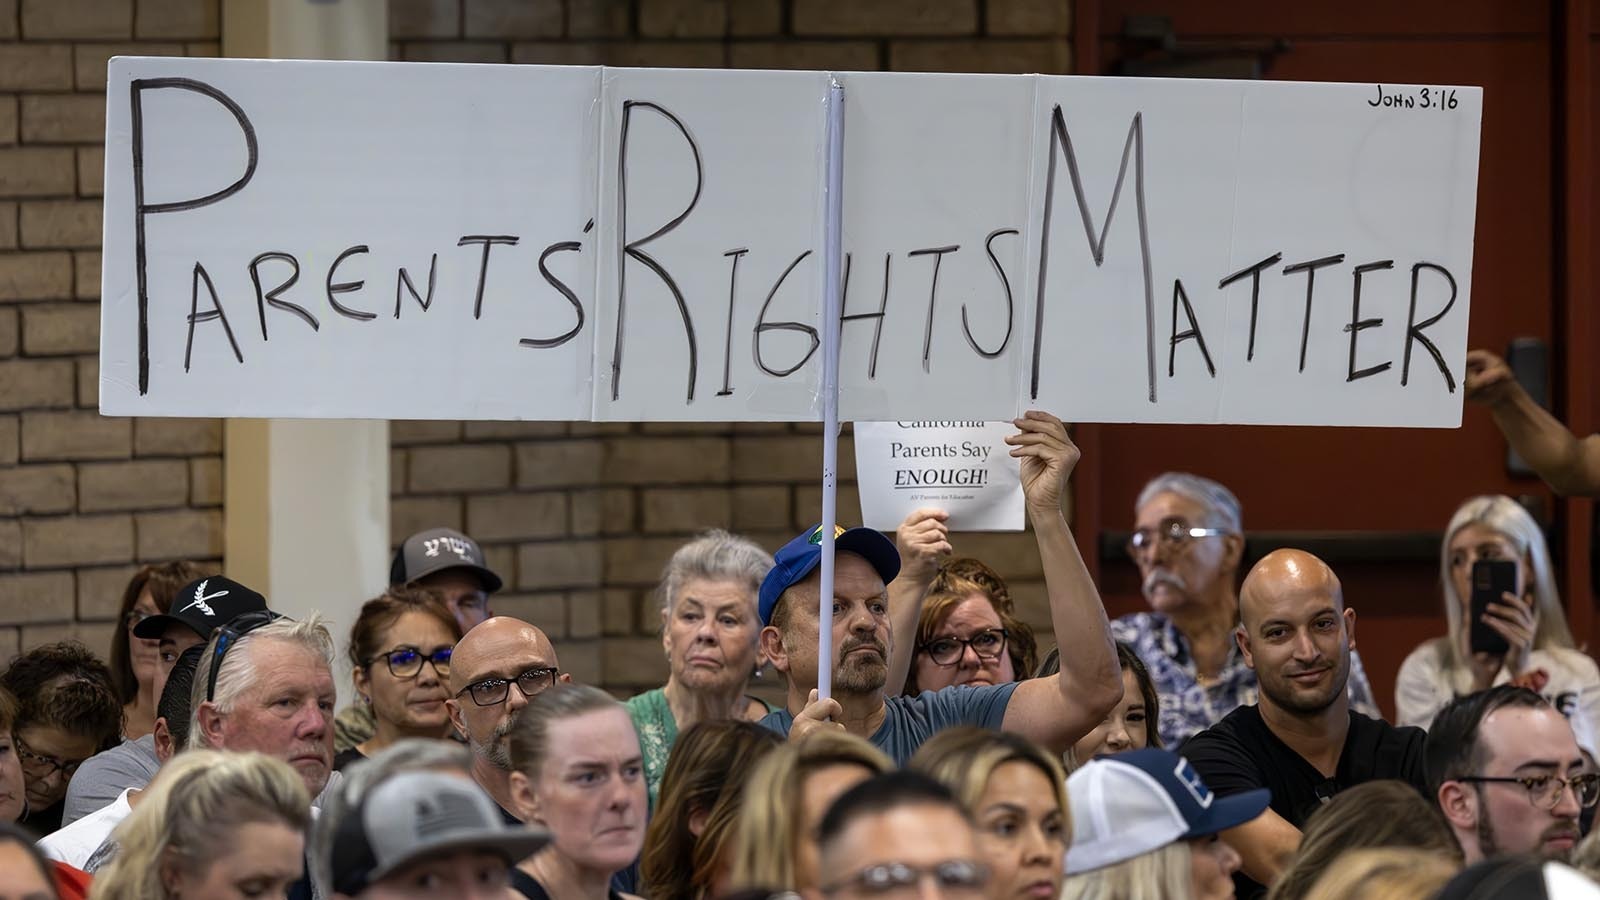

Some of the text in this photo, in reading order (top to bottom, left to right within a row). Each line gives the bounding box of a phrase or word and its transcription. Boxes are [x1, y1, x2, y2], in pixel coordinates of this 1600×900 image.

[1368, 85, 1458, 110] JOHN 3:16
[611, 99, 1019, 404] RIGHTS
[1032, 103, 1458, 403] MATTER
[891, 441, 991, 462] Parents Say
[895, 469, 988, 486] ENOUGH!
